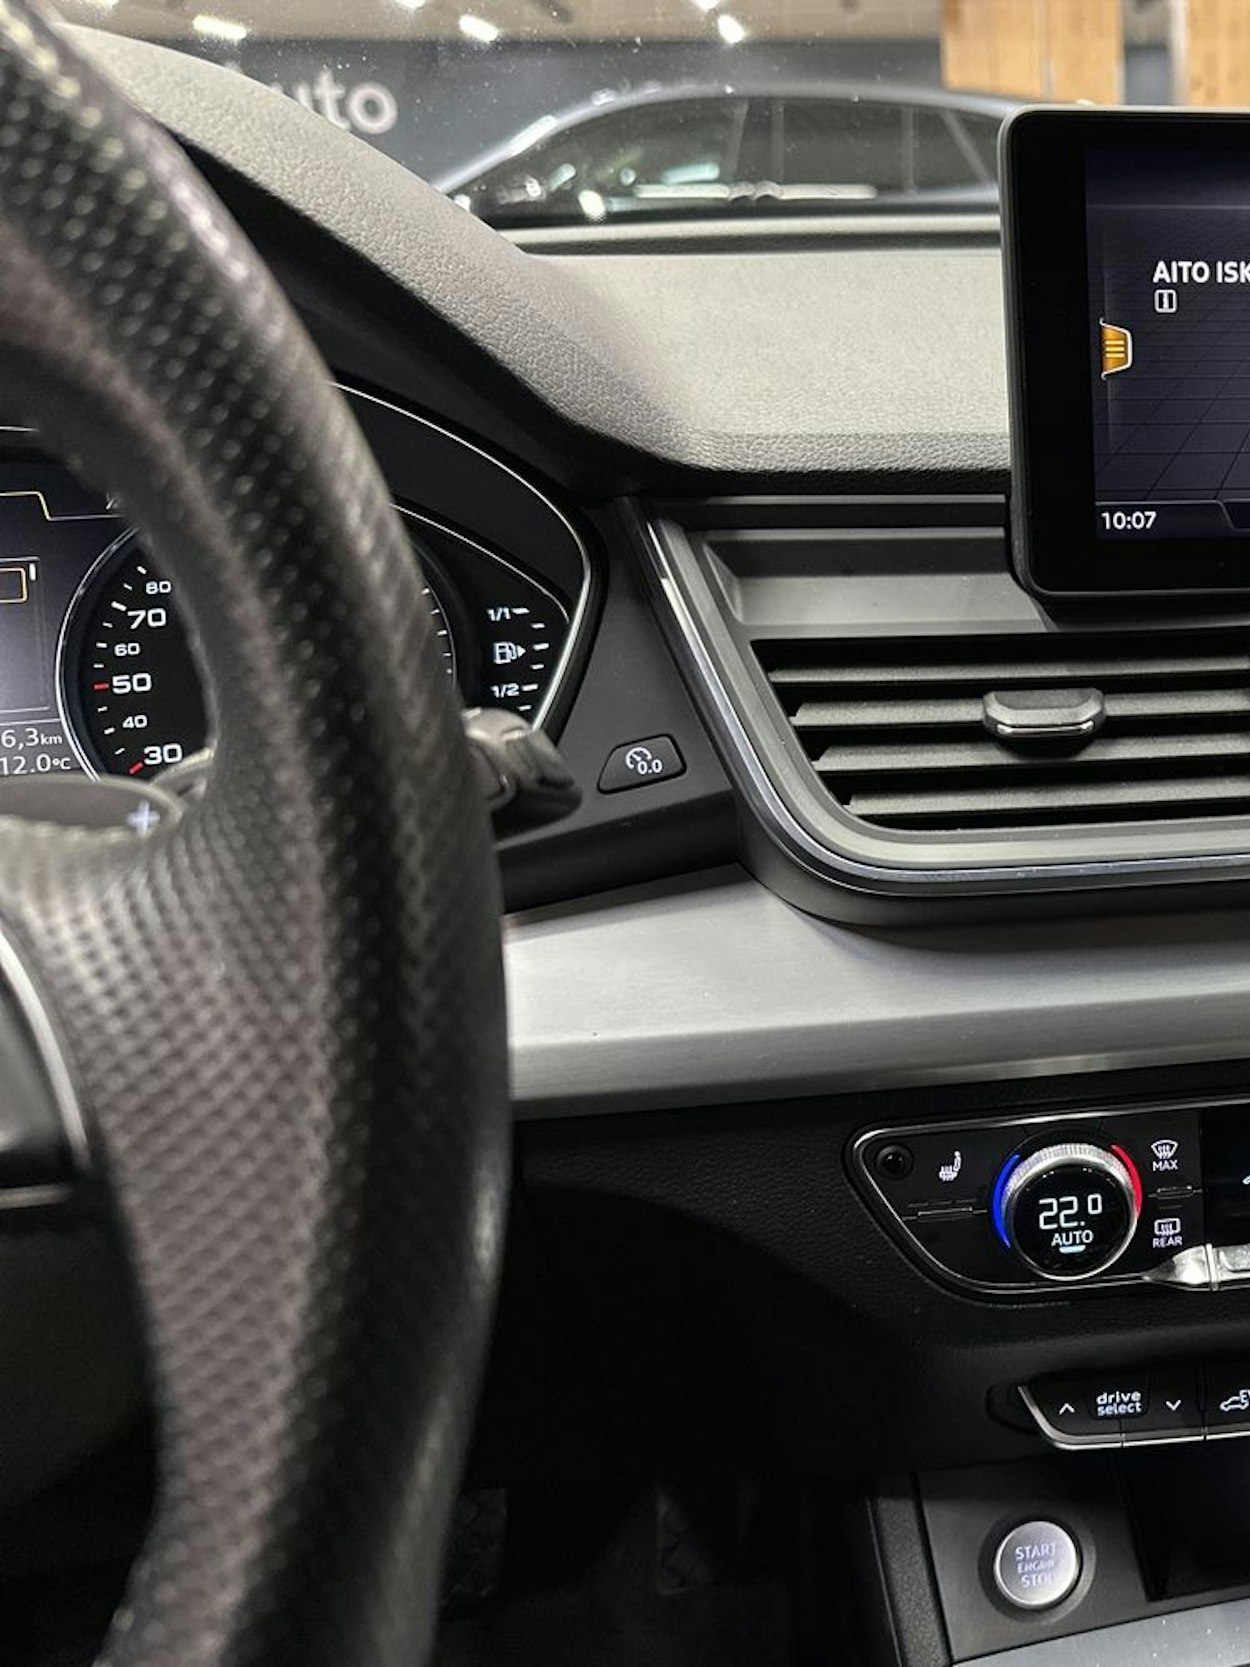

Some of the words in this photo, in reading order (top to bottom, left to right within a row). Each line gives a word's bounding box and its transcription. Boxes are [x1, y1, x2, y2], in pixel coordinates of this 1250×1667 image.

[1152, 261, 1210, 284] AITO
[1100, 510, 1157, 530] 10:07
[145, 580, 172, 595] 80
[127, 607, 167, 630] 70
[487, 607, 511, 621] 1/1
[114, 642, 140, 657] 60
[112, 673, 152, 694] 50
[491, 683, 520, 698] 1/2
[122, 715, 148, 729] 40
[143, 744, 183, 766] 30
[1152, 1159, 1178, 1172] MAX
[1039, 1193, 1102, 1230] 22.0
[1050, 1230, 1094, 1248] AUTO
[1152, 1236, 1183, 1249] REAR
[1096, 1390, 1142, 1405] drive
[1097, 1401, 1143, 1417] select
[1015, 1542, 1056, 1561] START
